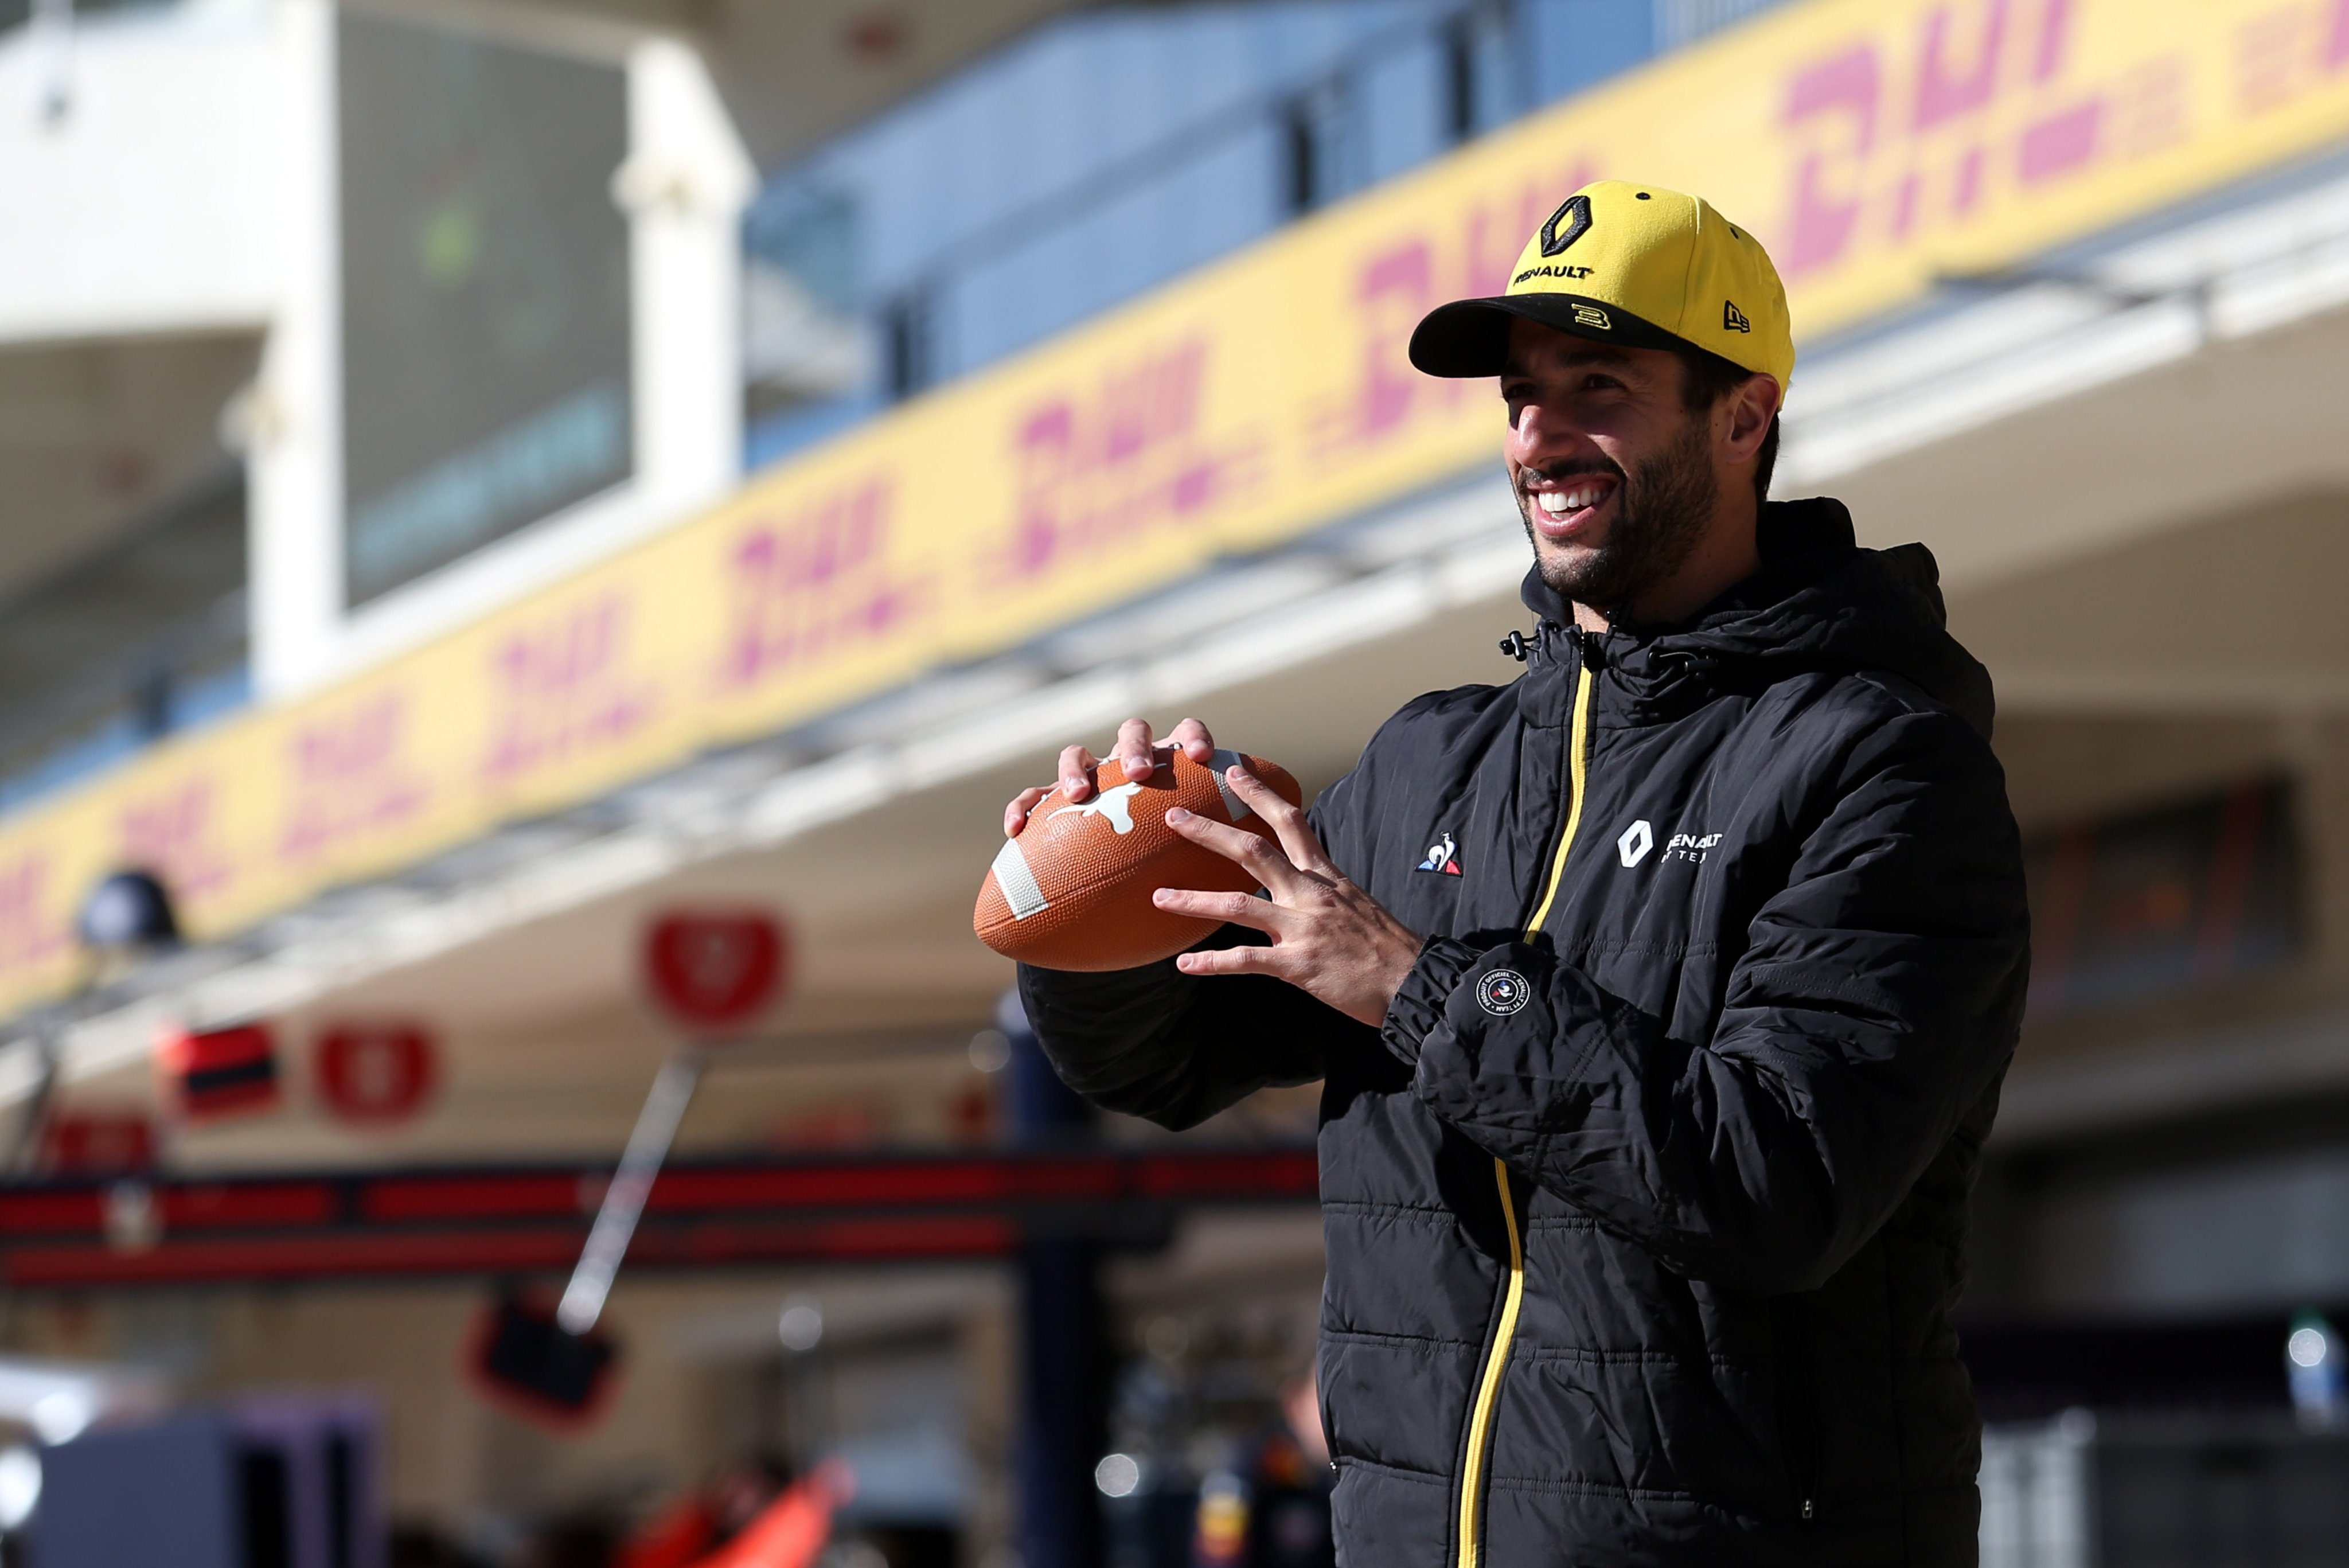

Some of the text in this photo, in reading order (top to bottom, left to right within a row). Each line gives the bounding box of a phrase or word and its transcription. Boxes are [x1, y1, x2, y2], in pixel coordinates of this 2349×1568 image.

[1513, 266, 1591, 286] RENAULT
[1571, 303, 1611, 330] 3
[1480, 972, 1510, 1007] PRODUIT OFFICIEL
